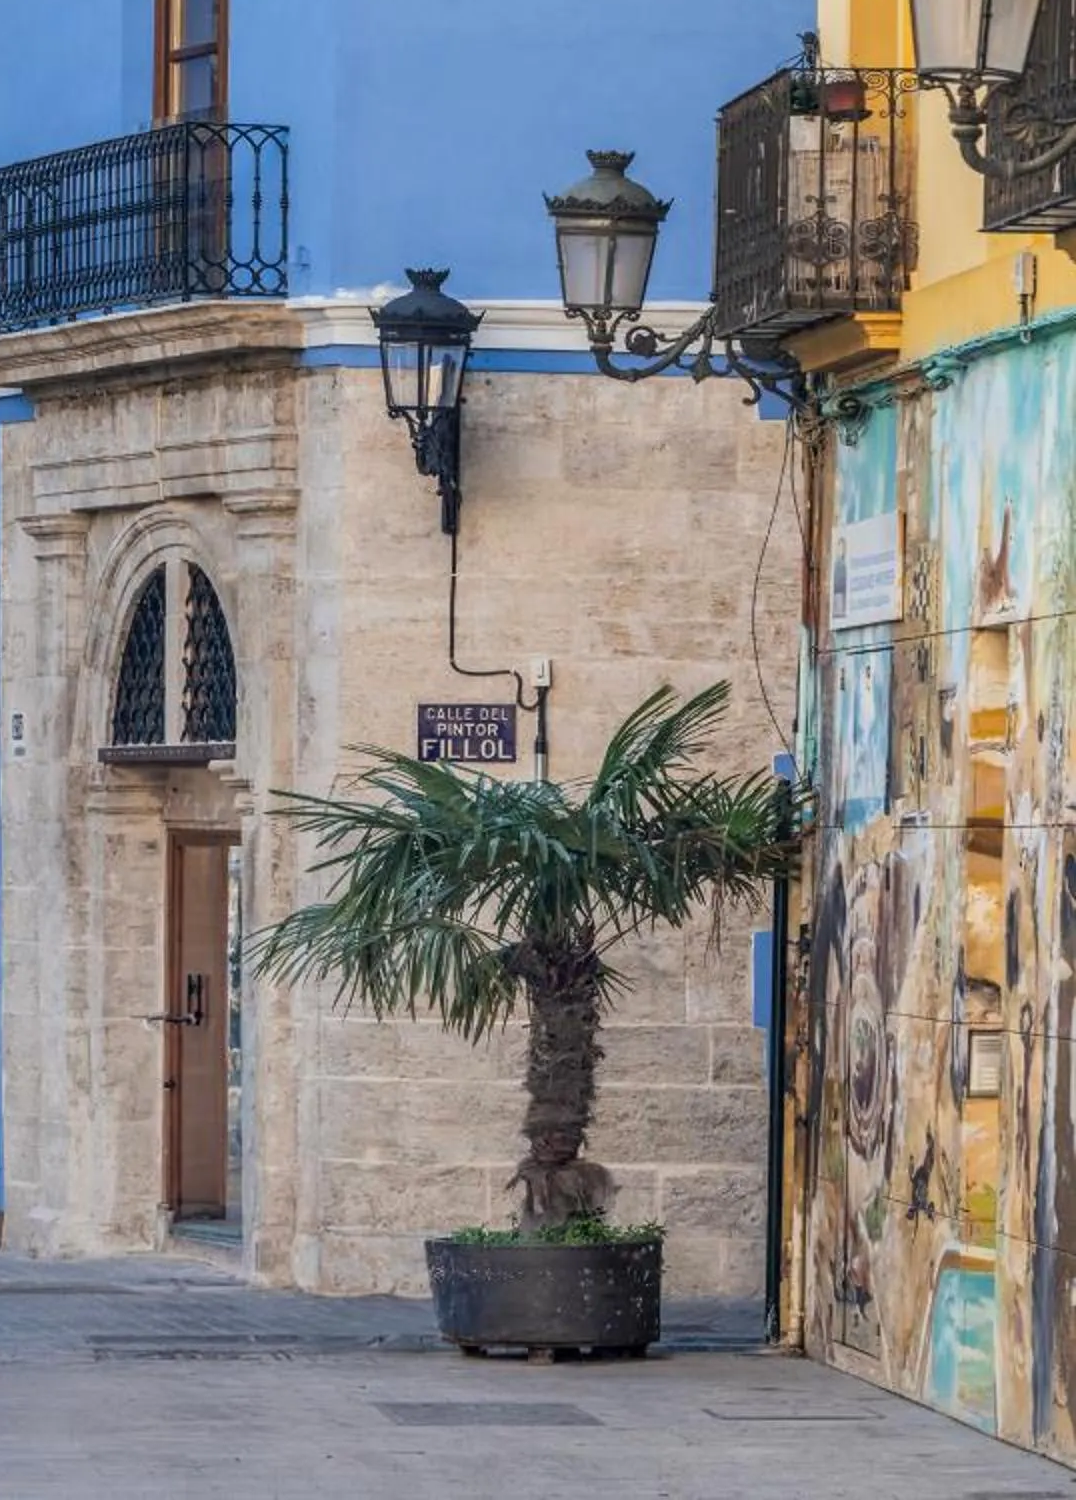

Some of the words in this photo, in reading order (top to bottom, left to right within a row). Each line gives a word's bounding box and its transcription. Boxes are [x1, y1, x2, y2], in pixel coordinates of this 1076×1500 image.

[427, 708, 473, 720] CALLE
[480, 708, 508, 721] DEL
[437, 724, 498, 736] PINTOR
[422, 739, 512, 759] FILLOL
